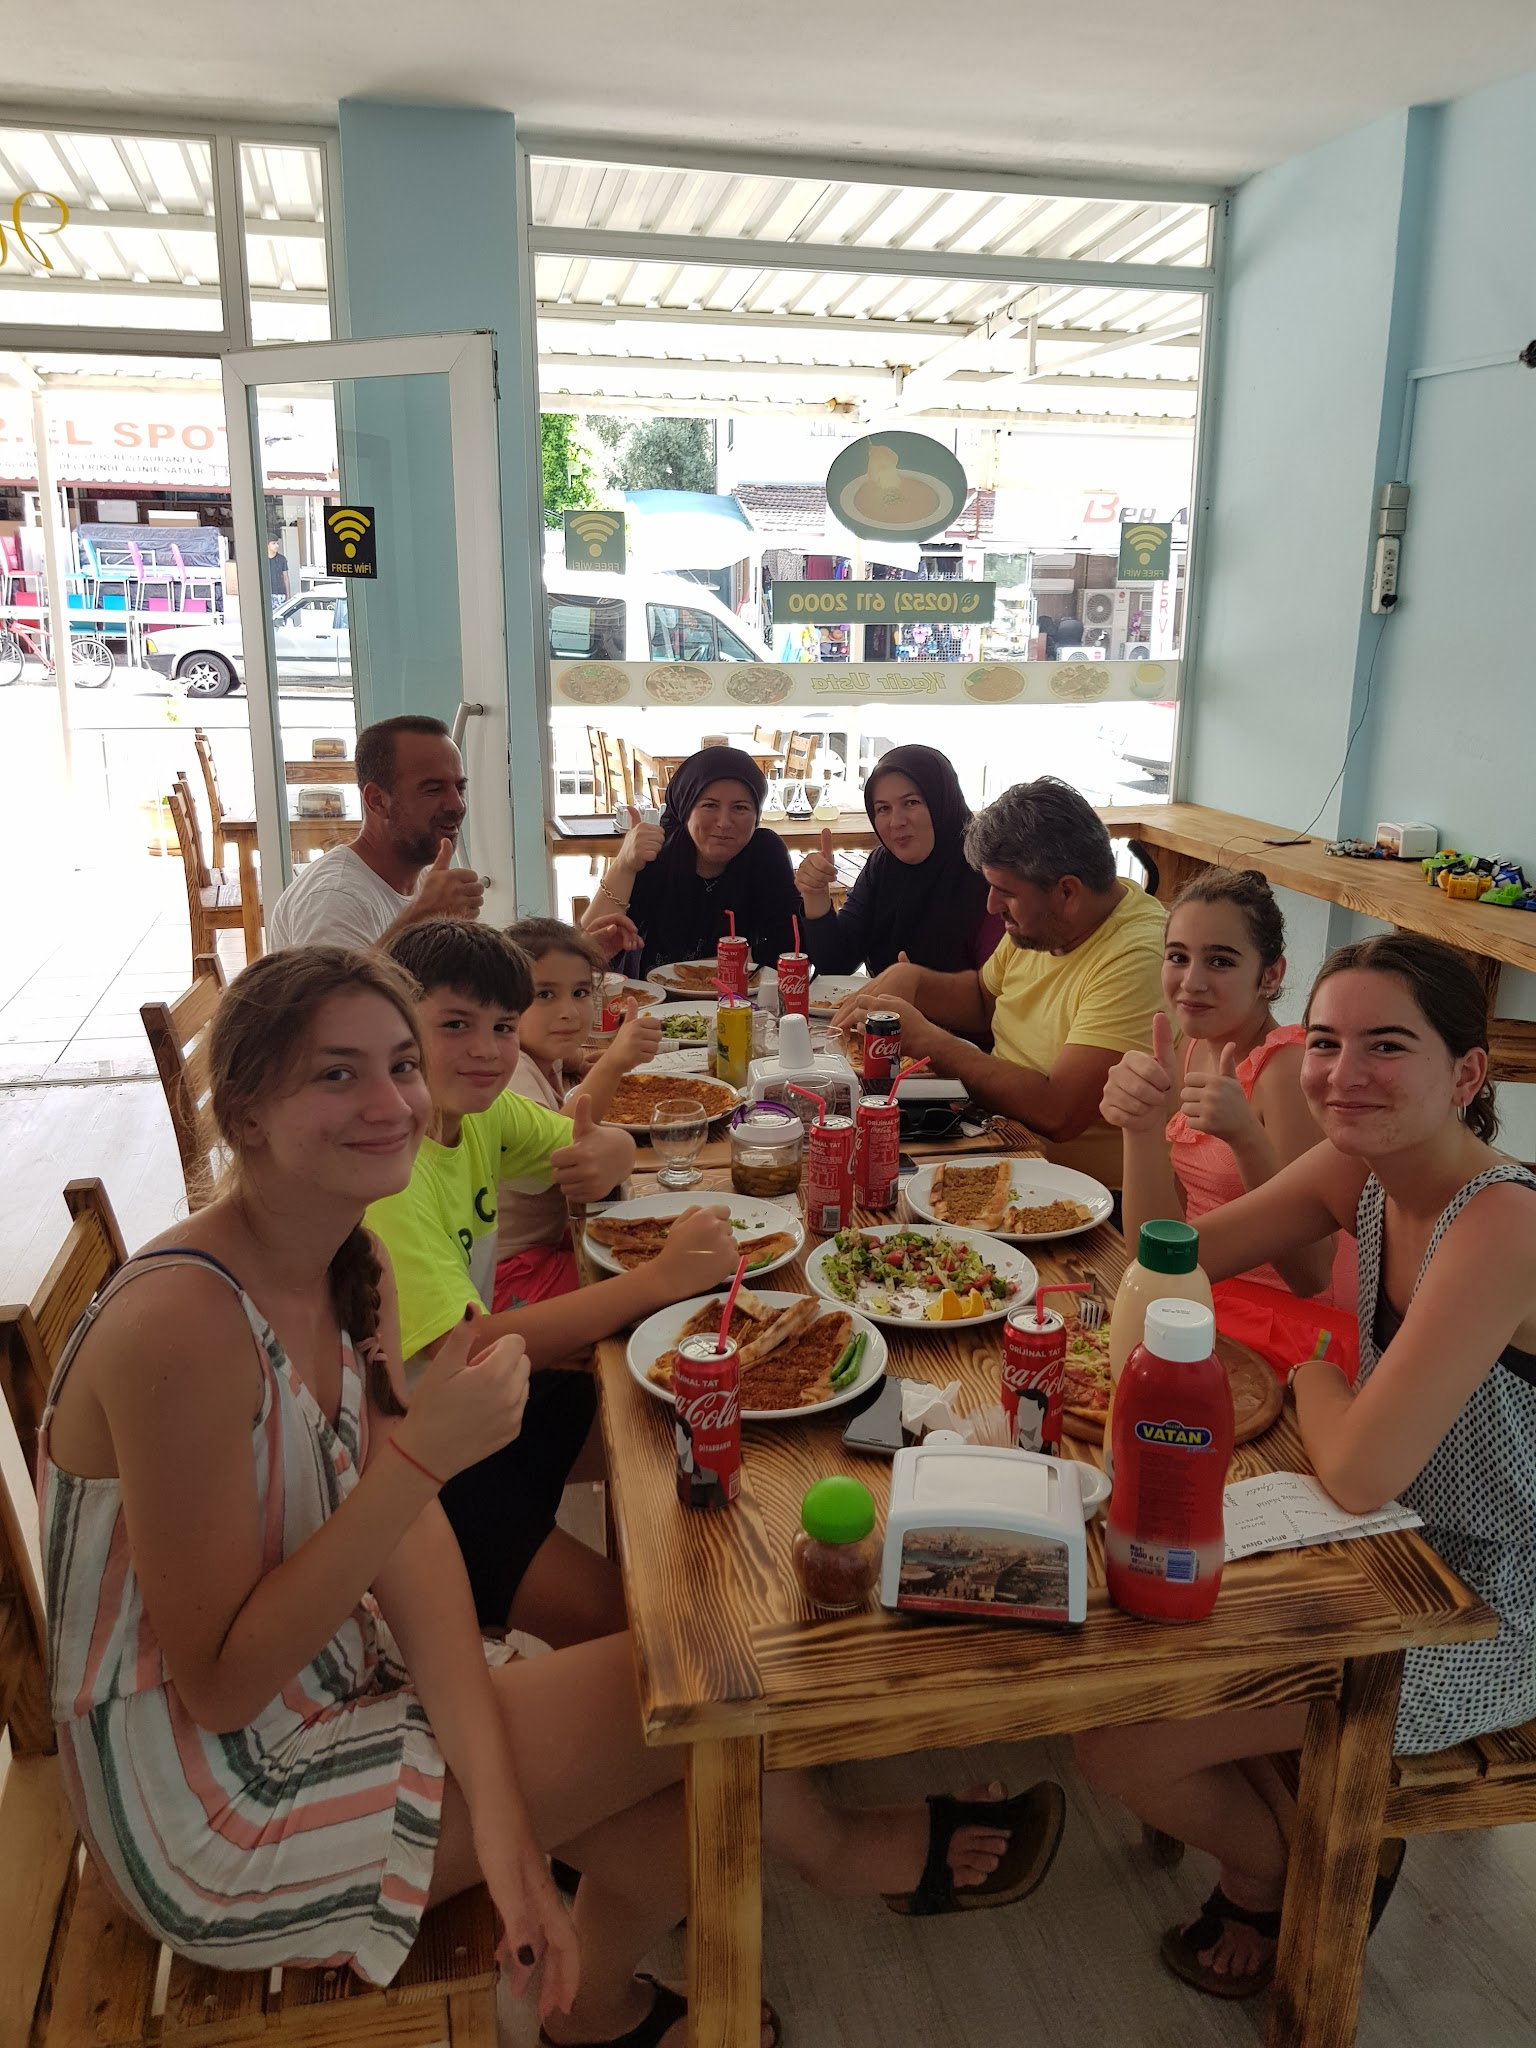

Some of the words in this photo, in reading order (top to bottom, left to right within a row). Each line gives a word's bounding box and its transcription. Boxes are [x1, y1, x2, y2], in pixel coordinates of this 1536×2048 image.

[114, 422, 227, 451] SPO
[331, 563, 353, 574] FREE
[1049, 1347, 1062, 1358] TAT
[702, 1379, 719, 1388] TAT
[1142, 1425, 1202, 1444] VATAN
